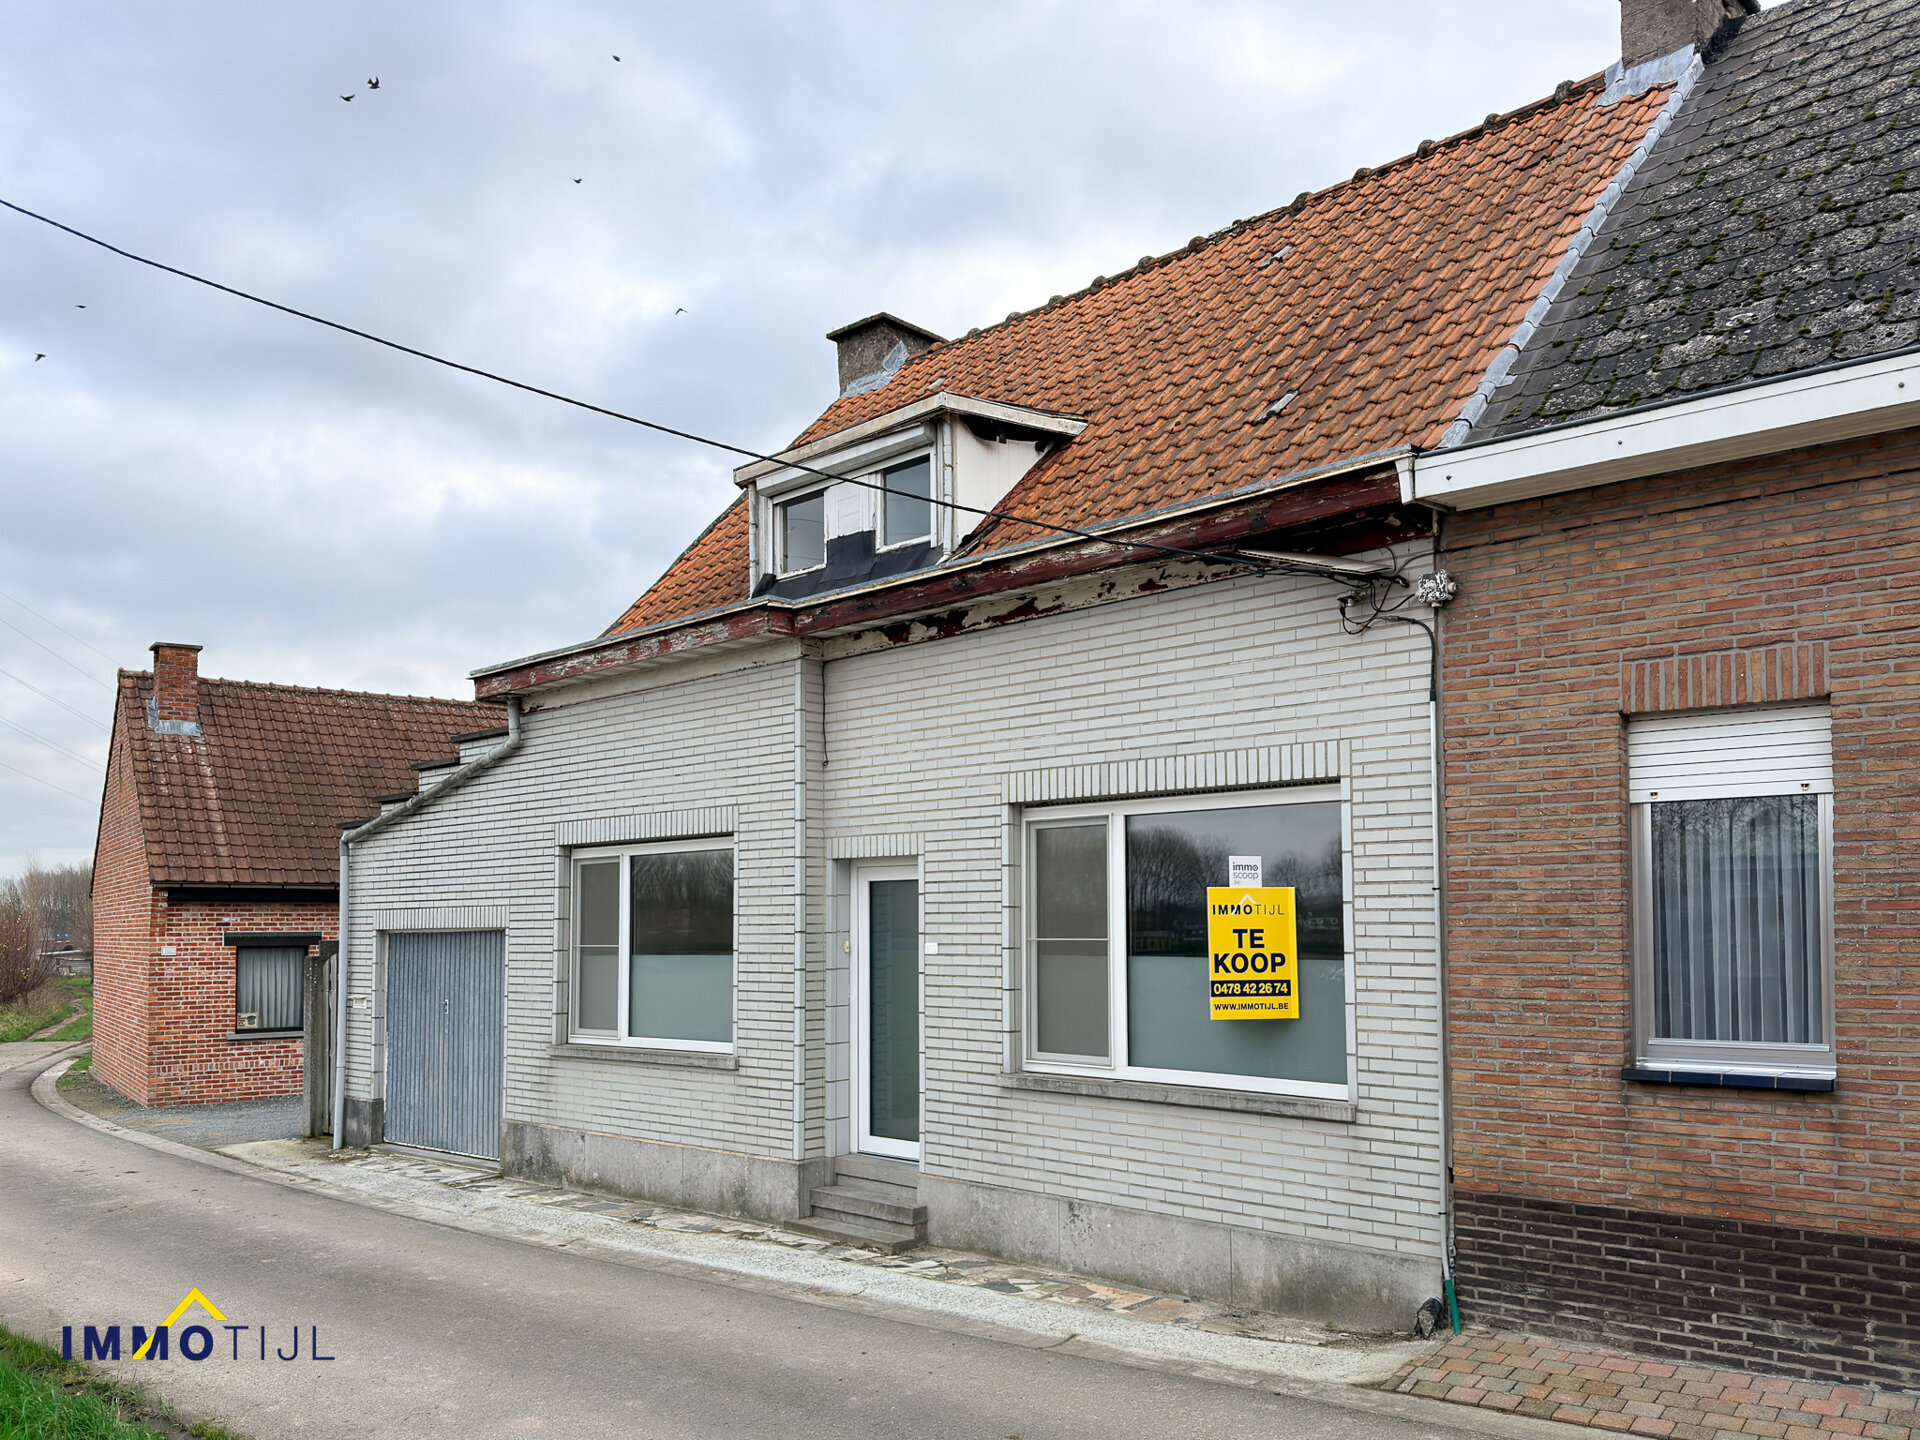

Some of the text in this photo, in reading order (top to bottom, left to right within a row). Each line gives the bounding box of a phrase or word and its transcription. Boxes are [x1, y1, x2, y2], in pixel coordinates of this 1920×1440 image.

[1233, 861, 1258, 871] immo
[1233, 872, 1259, 880] scoop
[1232, 928, 1265, 949] TE
[1213, 952, 1286, 974] KOOP
[1213, 982, 1288, 995] 0478 42 26 74
[1214, 1002, 1289, 1011] WWW.IMMOTIJL.BE
